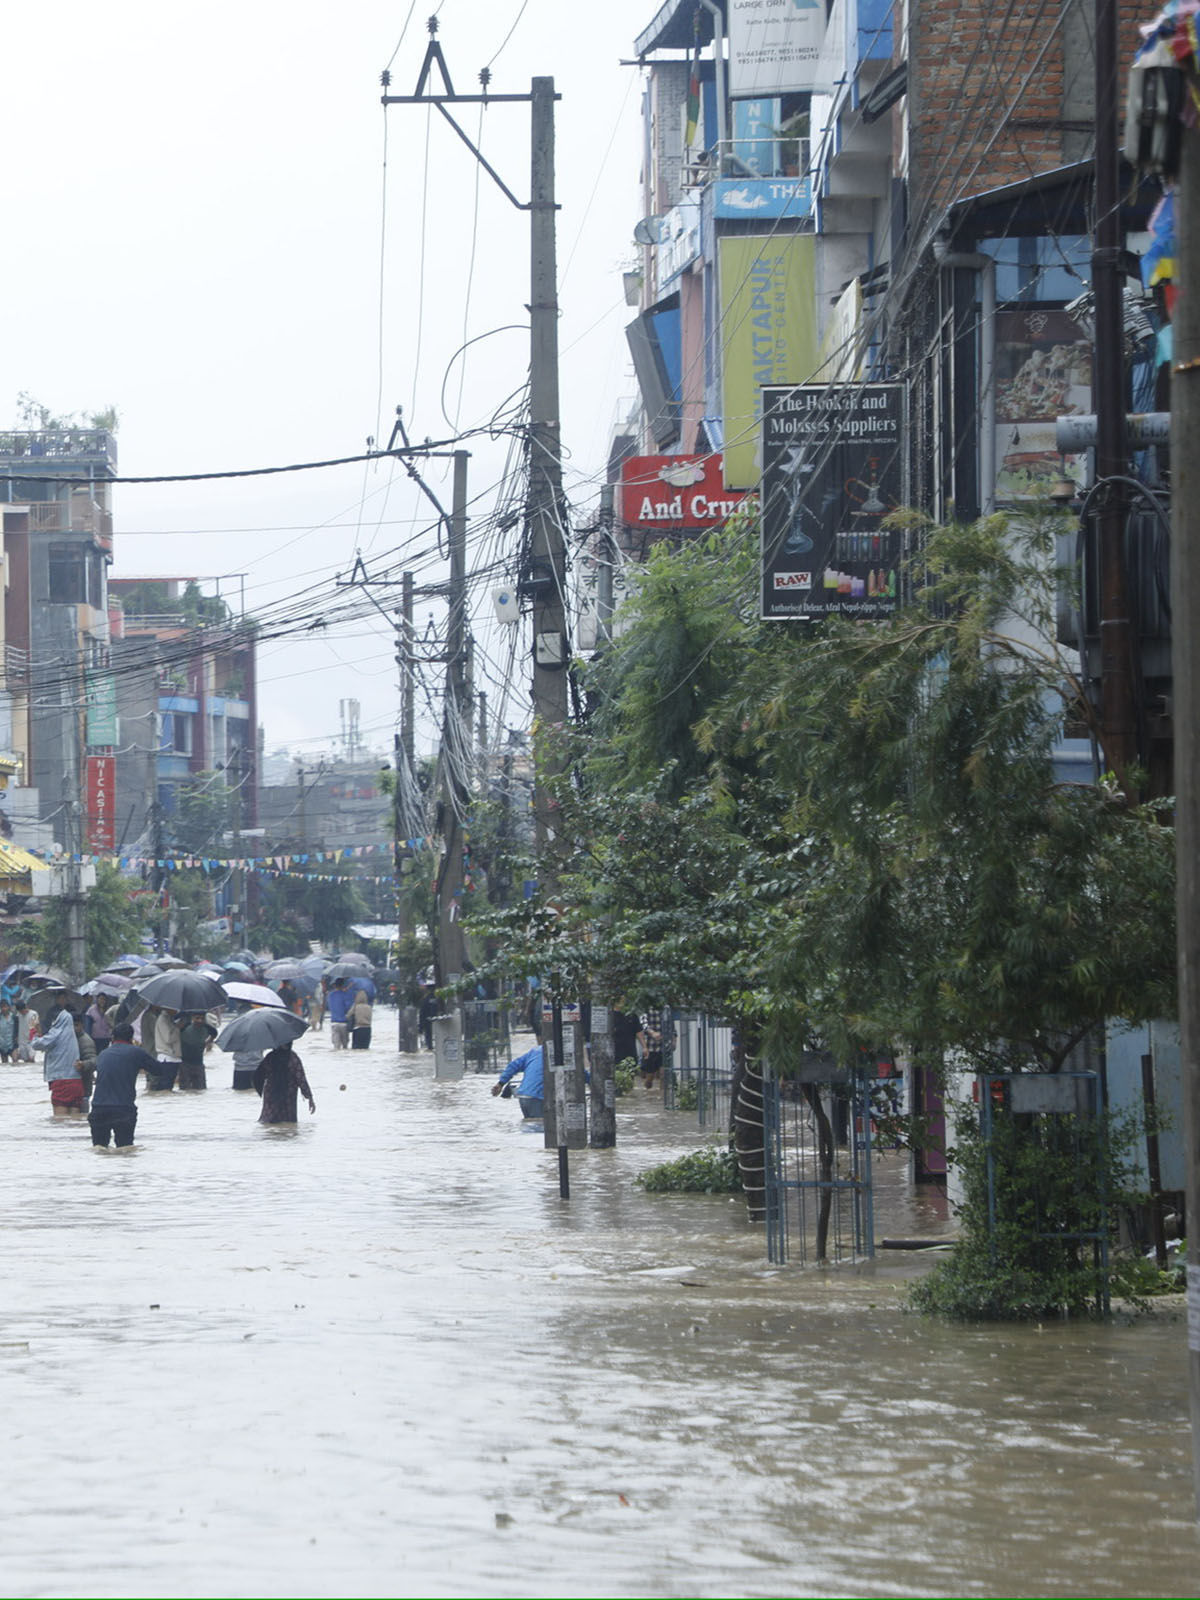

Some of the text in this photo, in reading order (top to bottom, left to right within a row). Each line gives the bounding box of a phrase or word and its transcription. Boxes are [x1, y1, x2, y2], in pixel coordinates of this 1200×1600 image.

[769, 184, 807, 199] THE
[776, 395, 803, 411] The
[862, 393, 887, 409] and
[638, 495, 683, 520] And
[775, 573, 809, 587] RAW
